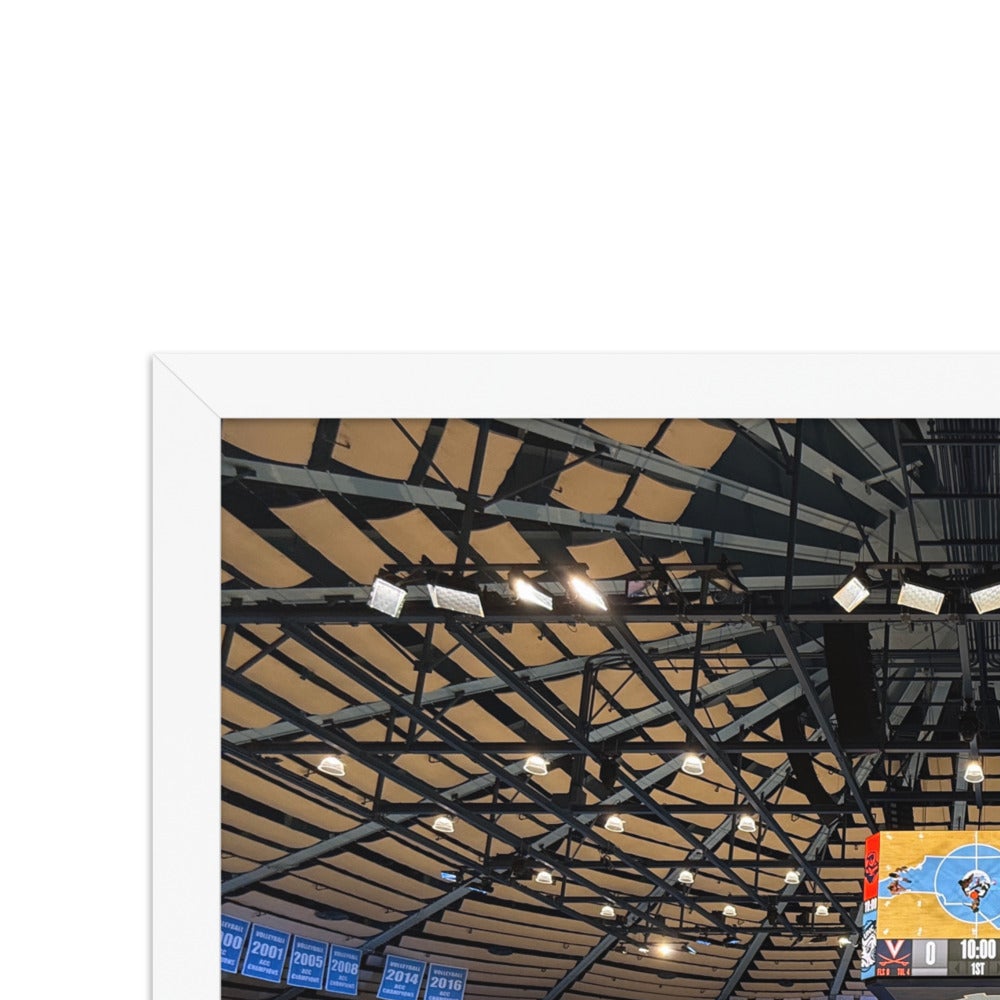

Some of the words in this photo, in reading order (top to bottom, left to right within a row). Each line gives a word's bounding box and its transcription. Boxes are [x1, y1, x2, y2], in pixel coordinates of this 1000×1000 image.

[220, 931, 243, 950] 00
[960, 939, 996, 959] 10:00
[251, 940, 284, 961] 2001
[925, 940, 936, 965] 0
[293, 951, 323, 969] 2005
[331, 959, 359, 975] 2008
[971, 962, 985, 975] 1ST
[385, 969, 419, 985] 2014
[430, 976, 463, 991] 2016
